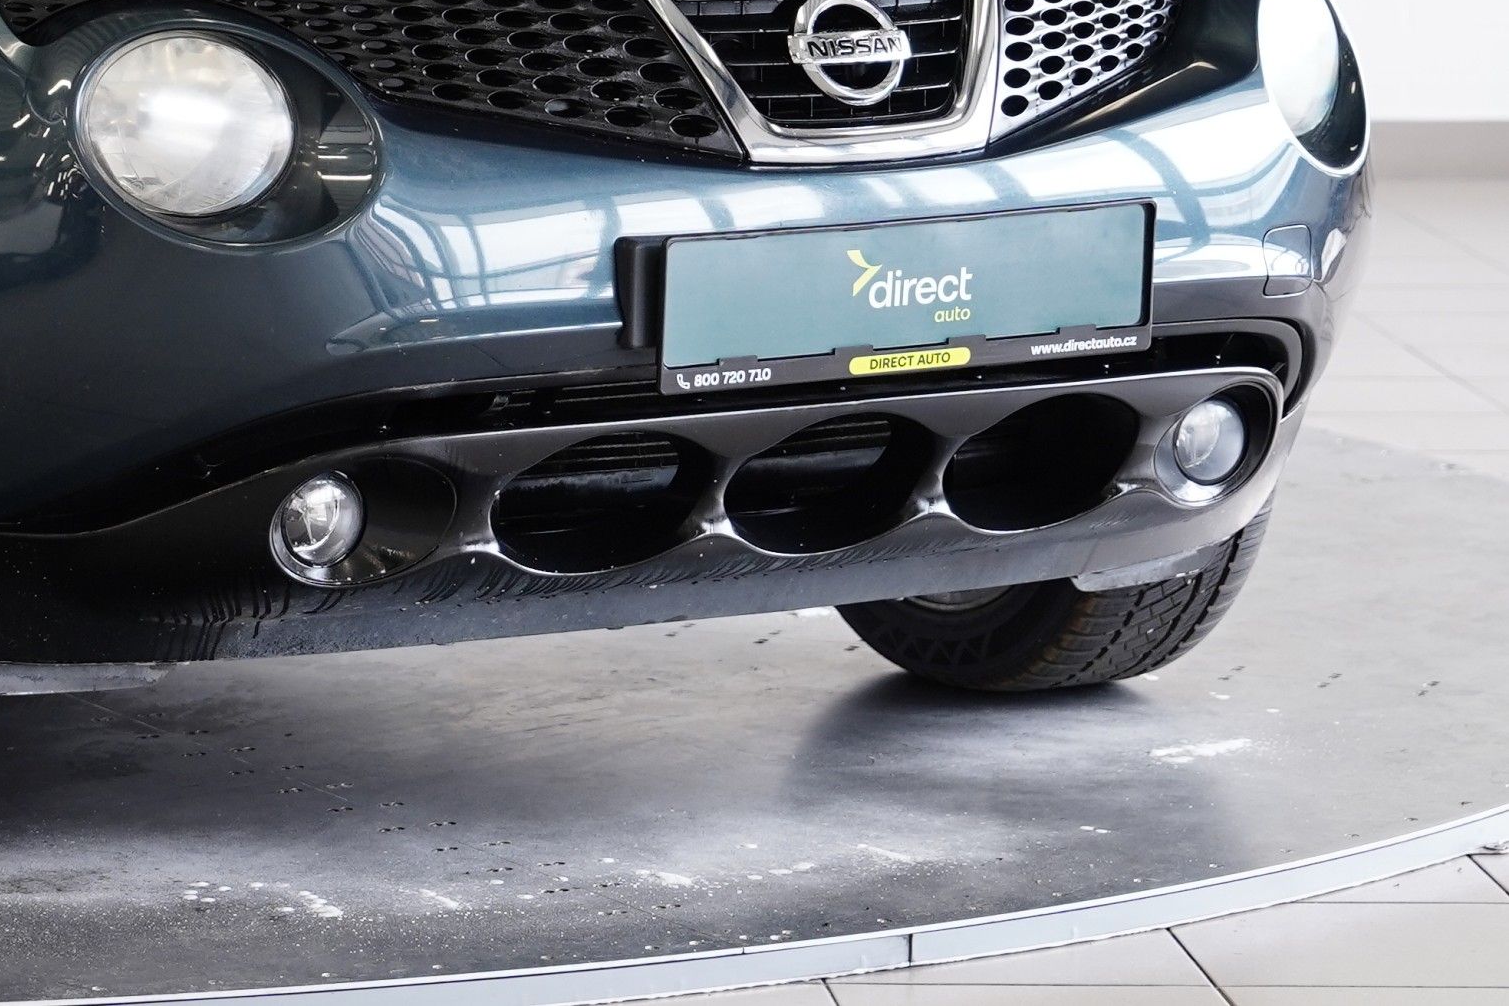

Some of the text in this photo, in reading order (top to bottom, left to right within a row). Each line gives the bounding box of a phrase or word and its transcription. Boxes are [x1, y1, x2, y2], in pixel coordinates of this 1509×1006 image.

[806, 37, 902, 57] NISSAN
[868, 267, 973, 310] direct
[934, 305, 971, 324] auto
[1031, 334, 1137, 356] www.directauto.cz
[870, 352, 951, 370] DIRECT AUTO
[694, 368, 771, 387] 800 720 710
